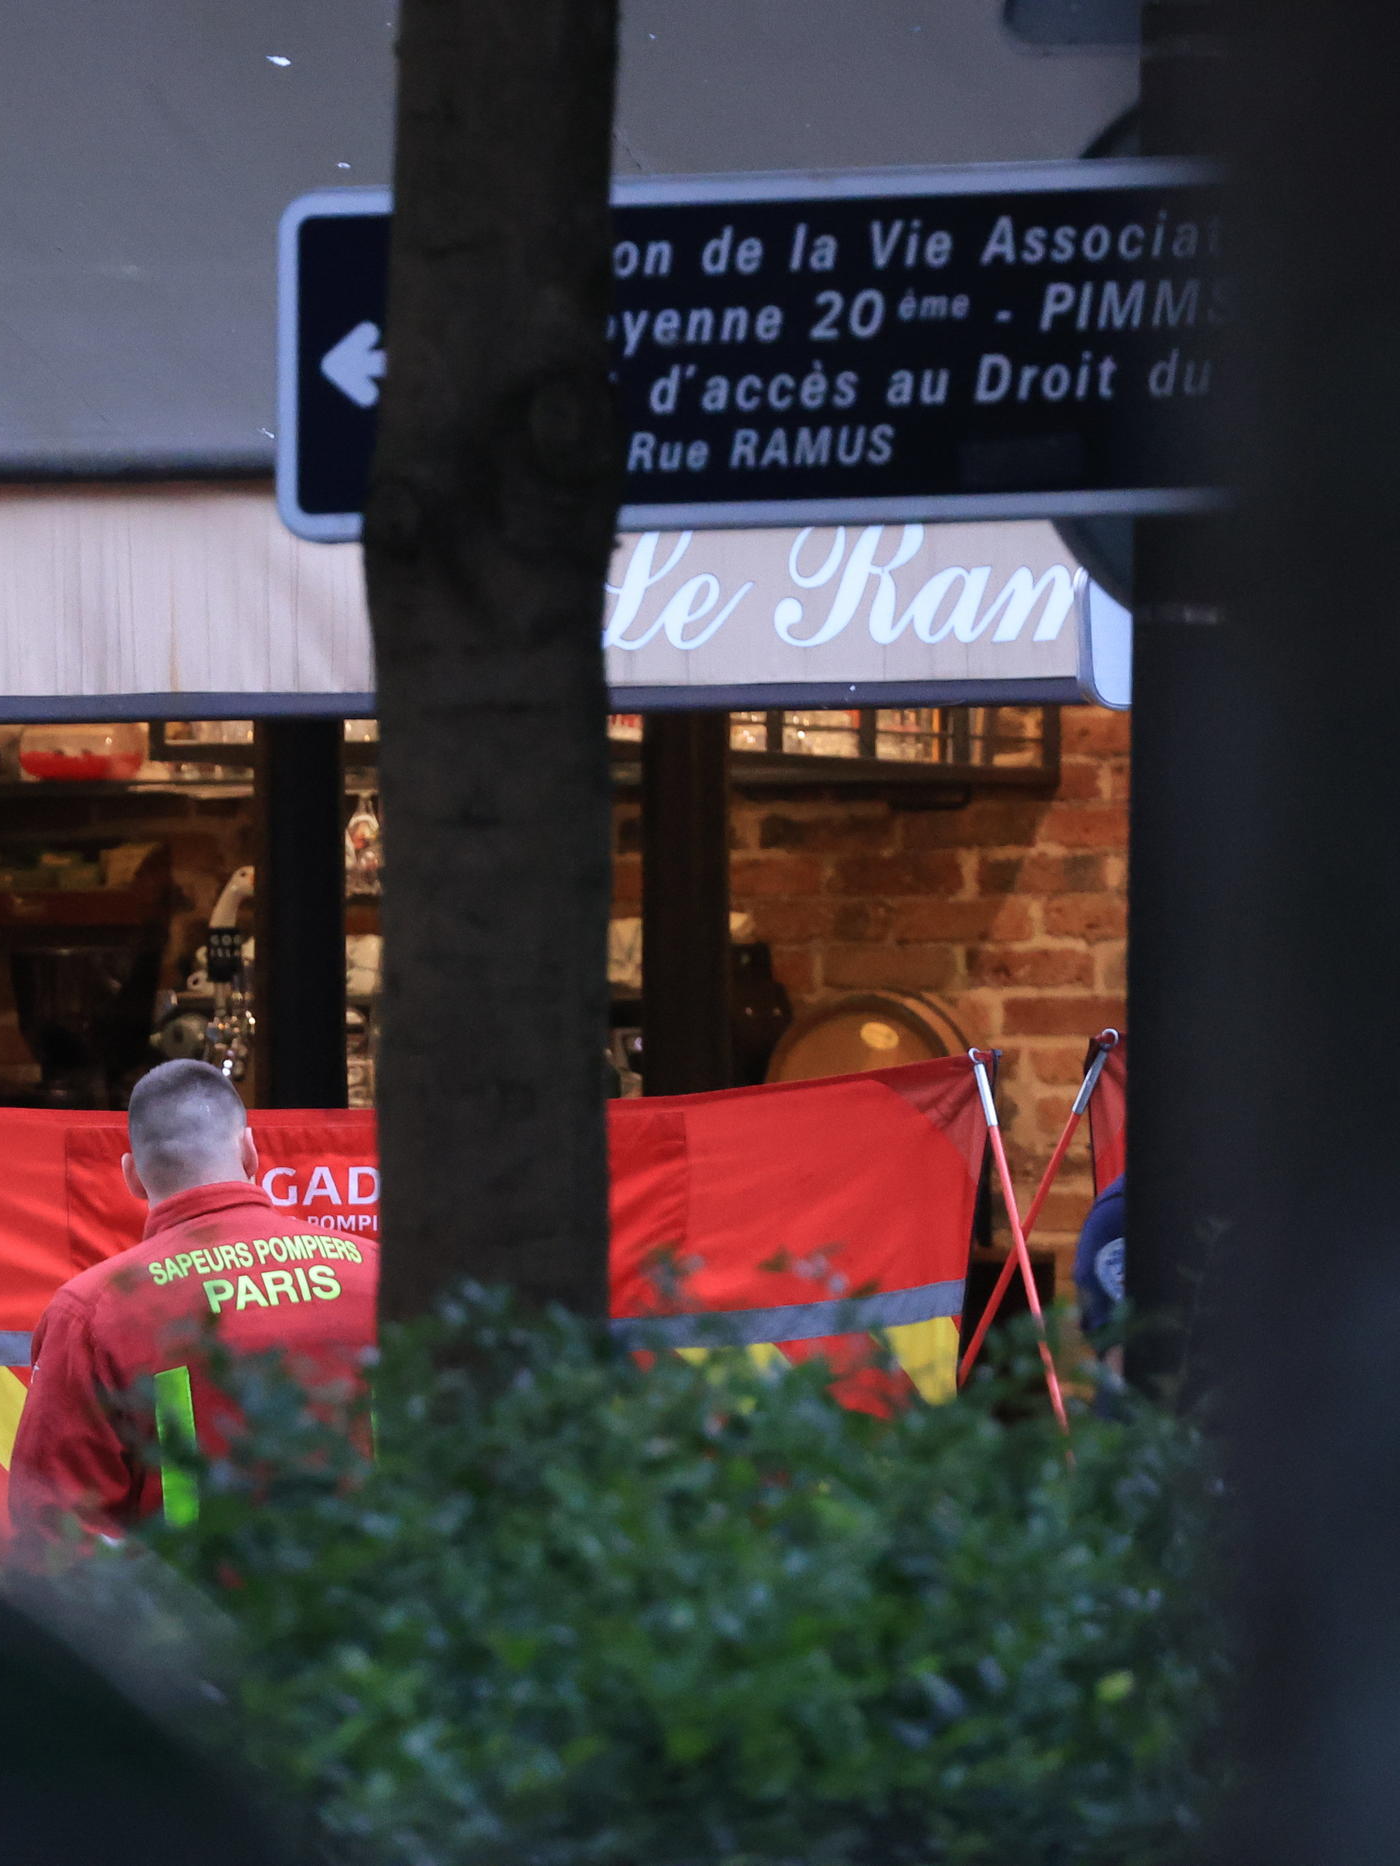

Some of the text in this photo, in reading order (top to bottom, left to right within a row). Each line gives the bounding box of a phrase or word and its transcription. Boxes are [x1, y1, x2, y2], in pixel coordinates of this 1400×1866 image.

[612, 210, 1222, 278] on de la Vie Associat
[606, 304, 784, 357] yenne
[650, 347, 1213, 415] d'accès au Droit du
[626, 423, 895, 473] Rue RAMUS
[603, 523, 1076, 650] Le Ram
[260, 1166, 380, 1206] GAD
[307, 1215, 378, 1231] POMPI
[149, 1234, 364, 1285] SAPEURS POMPIERS
[203, 1265, 342, 1314] PARIS
